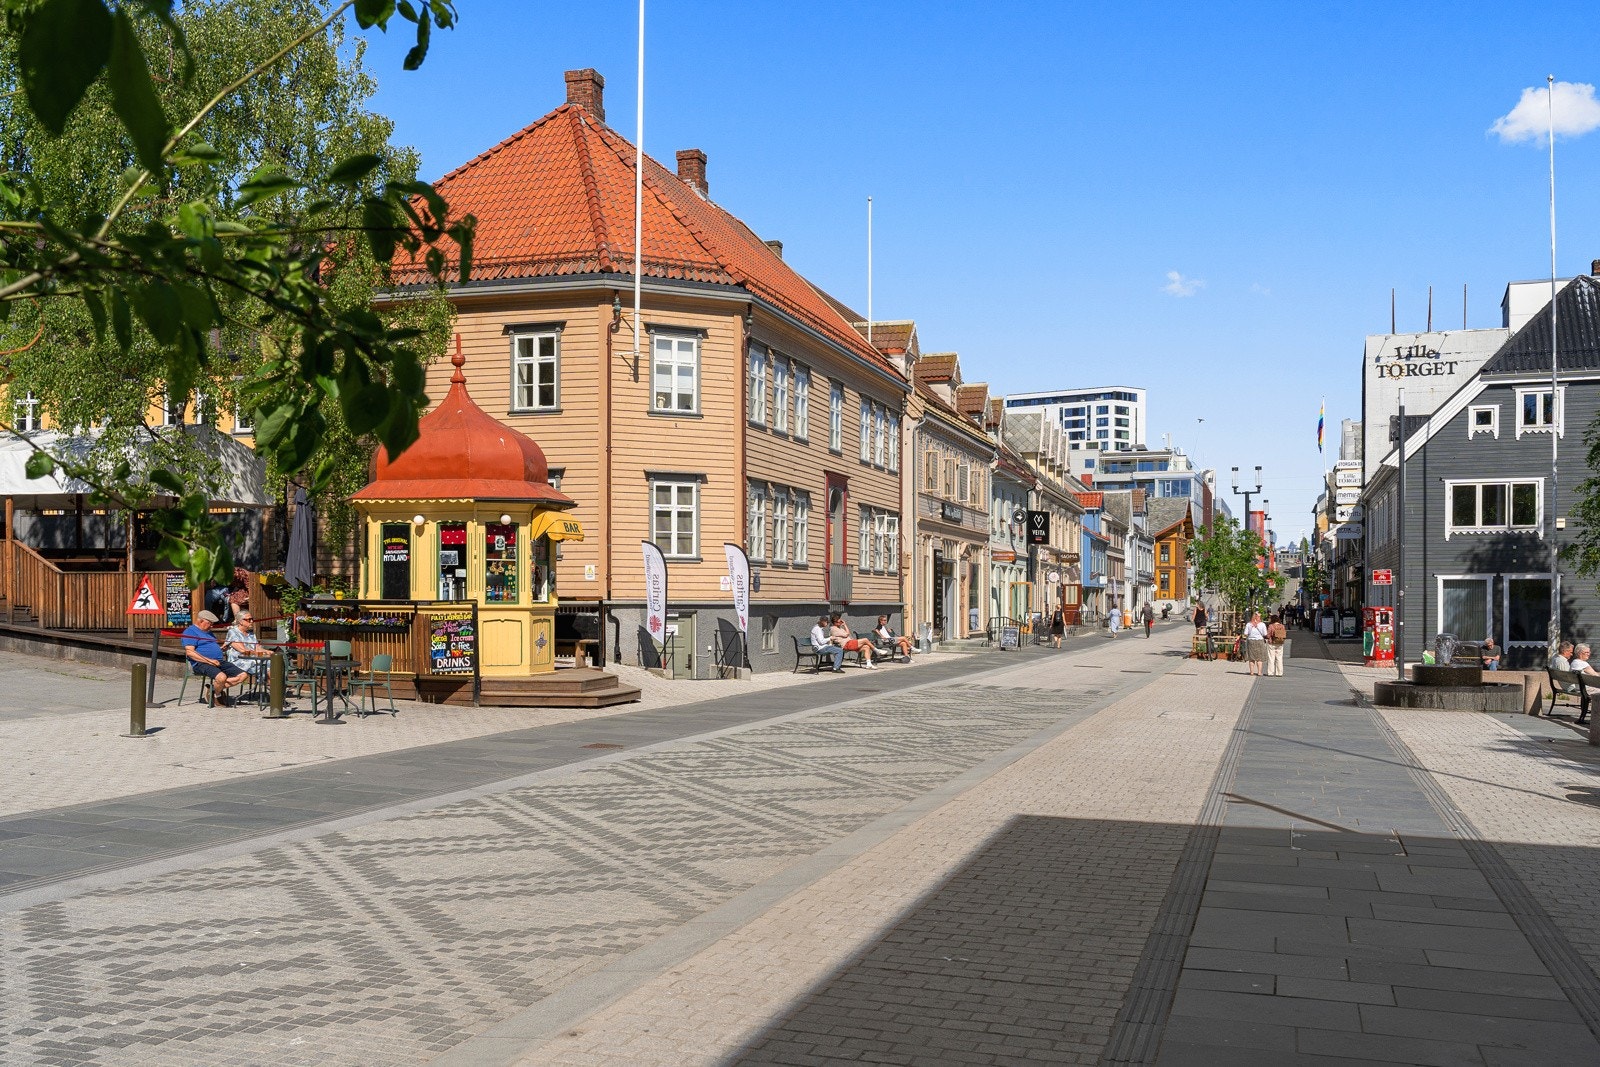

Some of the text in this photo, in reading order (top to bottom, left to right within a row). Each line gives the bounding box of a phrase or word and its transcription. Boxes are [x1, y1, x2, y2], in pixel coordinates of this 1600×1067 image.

[1394, 345, 1436, 360] Lille
[1375, 361, 1458, 379] TORGET
[564, 522, 580, 533] BAR
[432, 642, 446, 650] Soda
[436, 656, 470, 668] DRINKS
